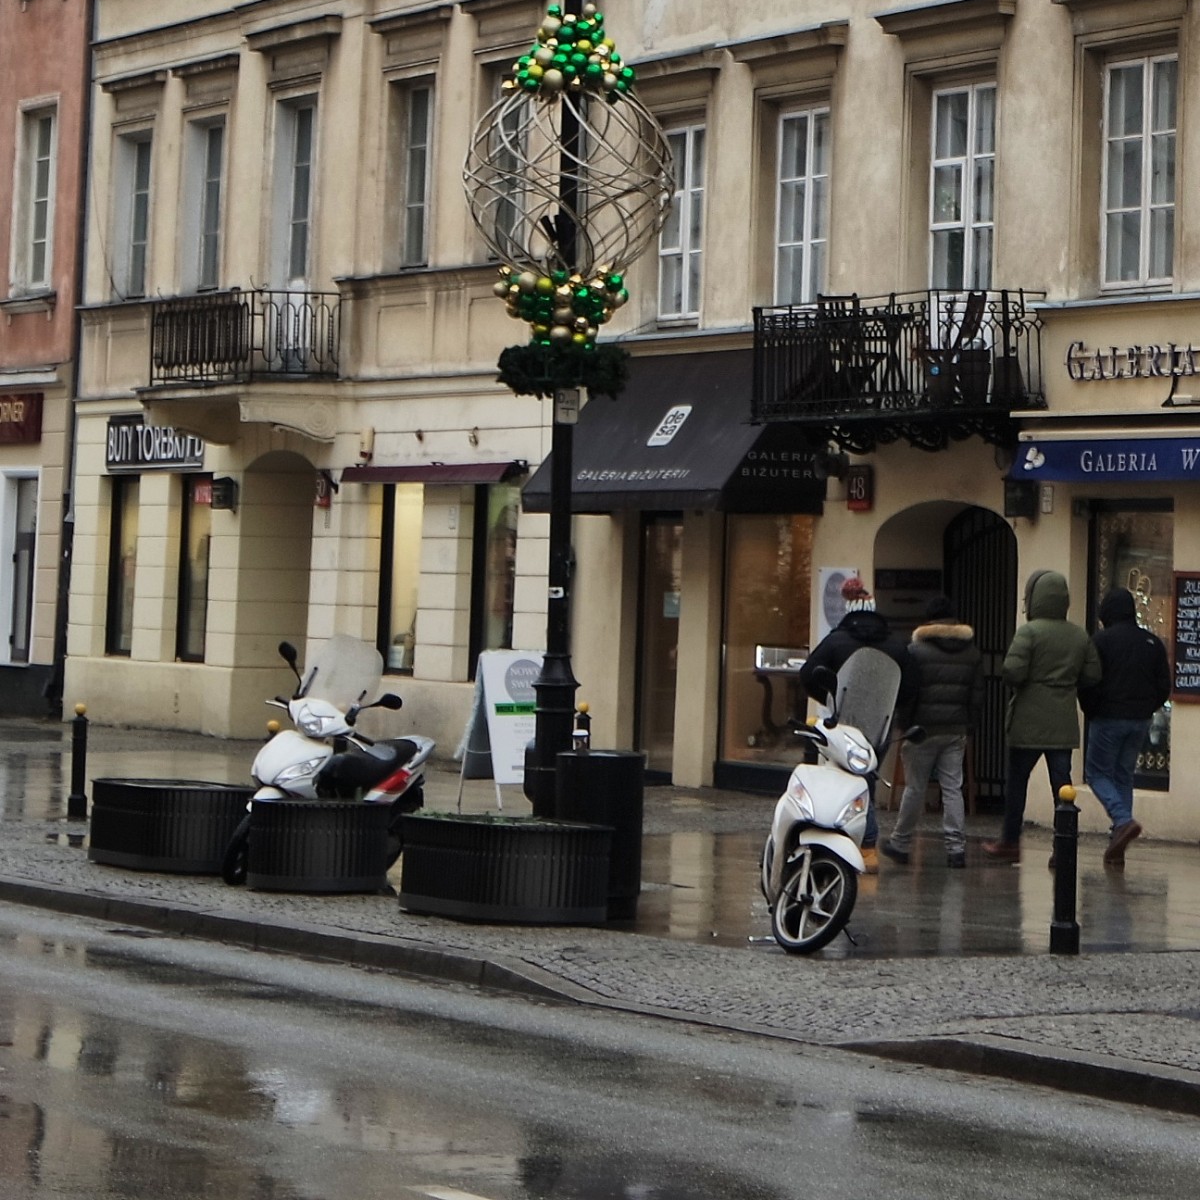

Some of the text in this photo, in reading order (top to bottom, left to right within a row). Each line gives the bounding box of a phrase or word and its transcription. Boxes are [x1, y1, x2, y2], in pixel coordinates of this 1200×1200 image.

[107, 425, 133, 462] BUTY
[748, 450, 817, 462] GALERIA
[1081, 449, 1158, 473] GALERIA
[577, 467, 690, 481] GALERIA BIŻUTERII
[850, 477, 865, 500] 48
